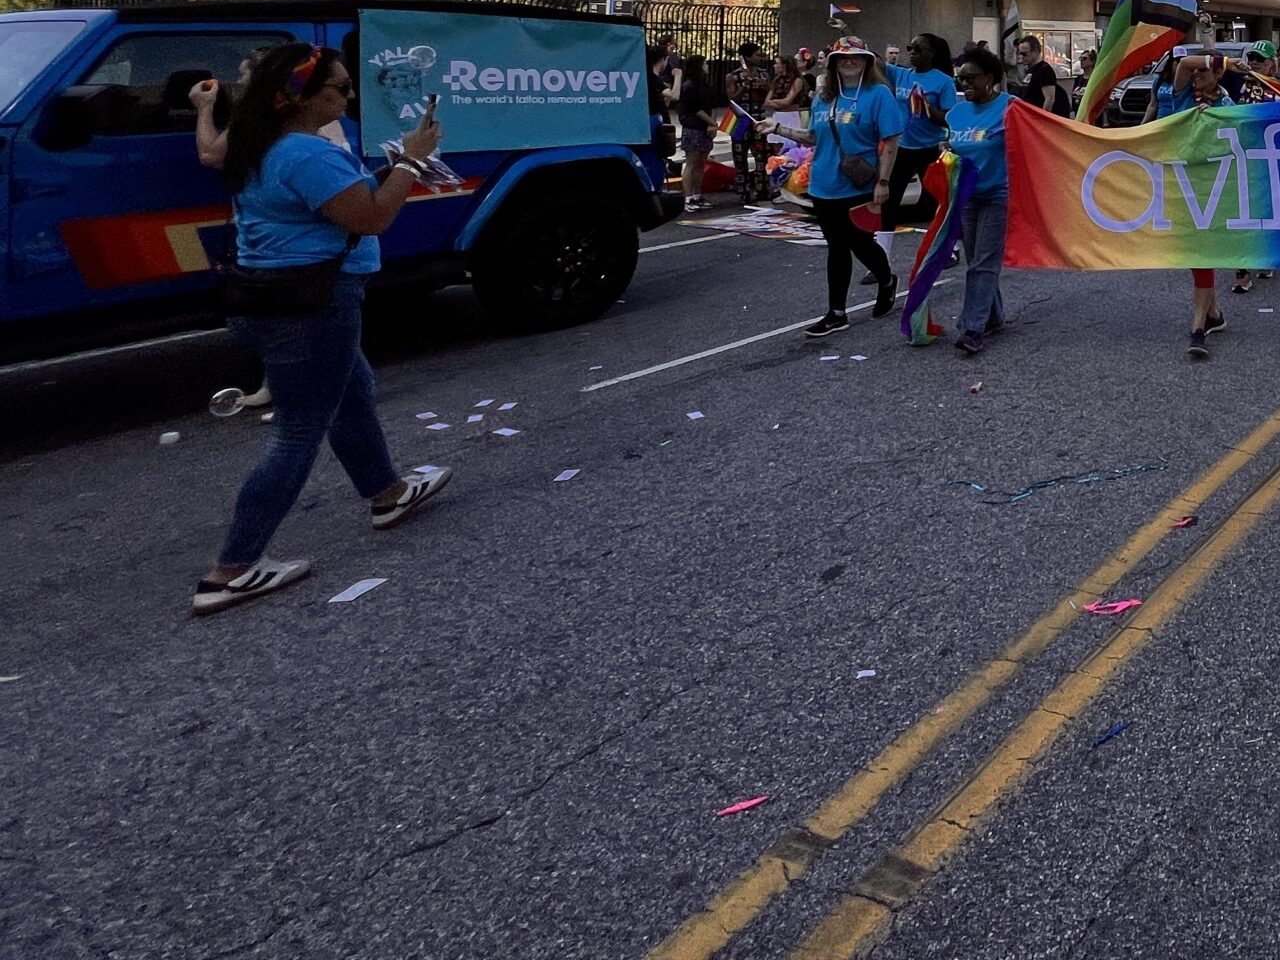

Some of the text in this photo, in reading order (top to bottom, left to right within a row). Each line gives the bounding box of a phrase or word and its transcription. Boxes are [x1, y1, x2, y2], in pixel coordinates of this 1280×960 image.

[443, 60, 640, 98] Removery
[452, 95, 622, 105] The world's tattoo removal experts
